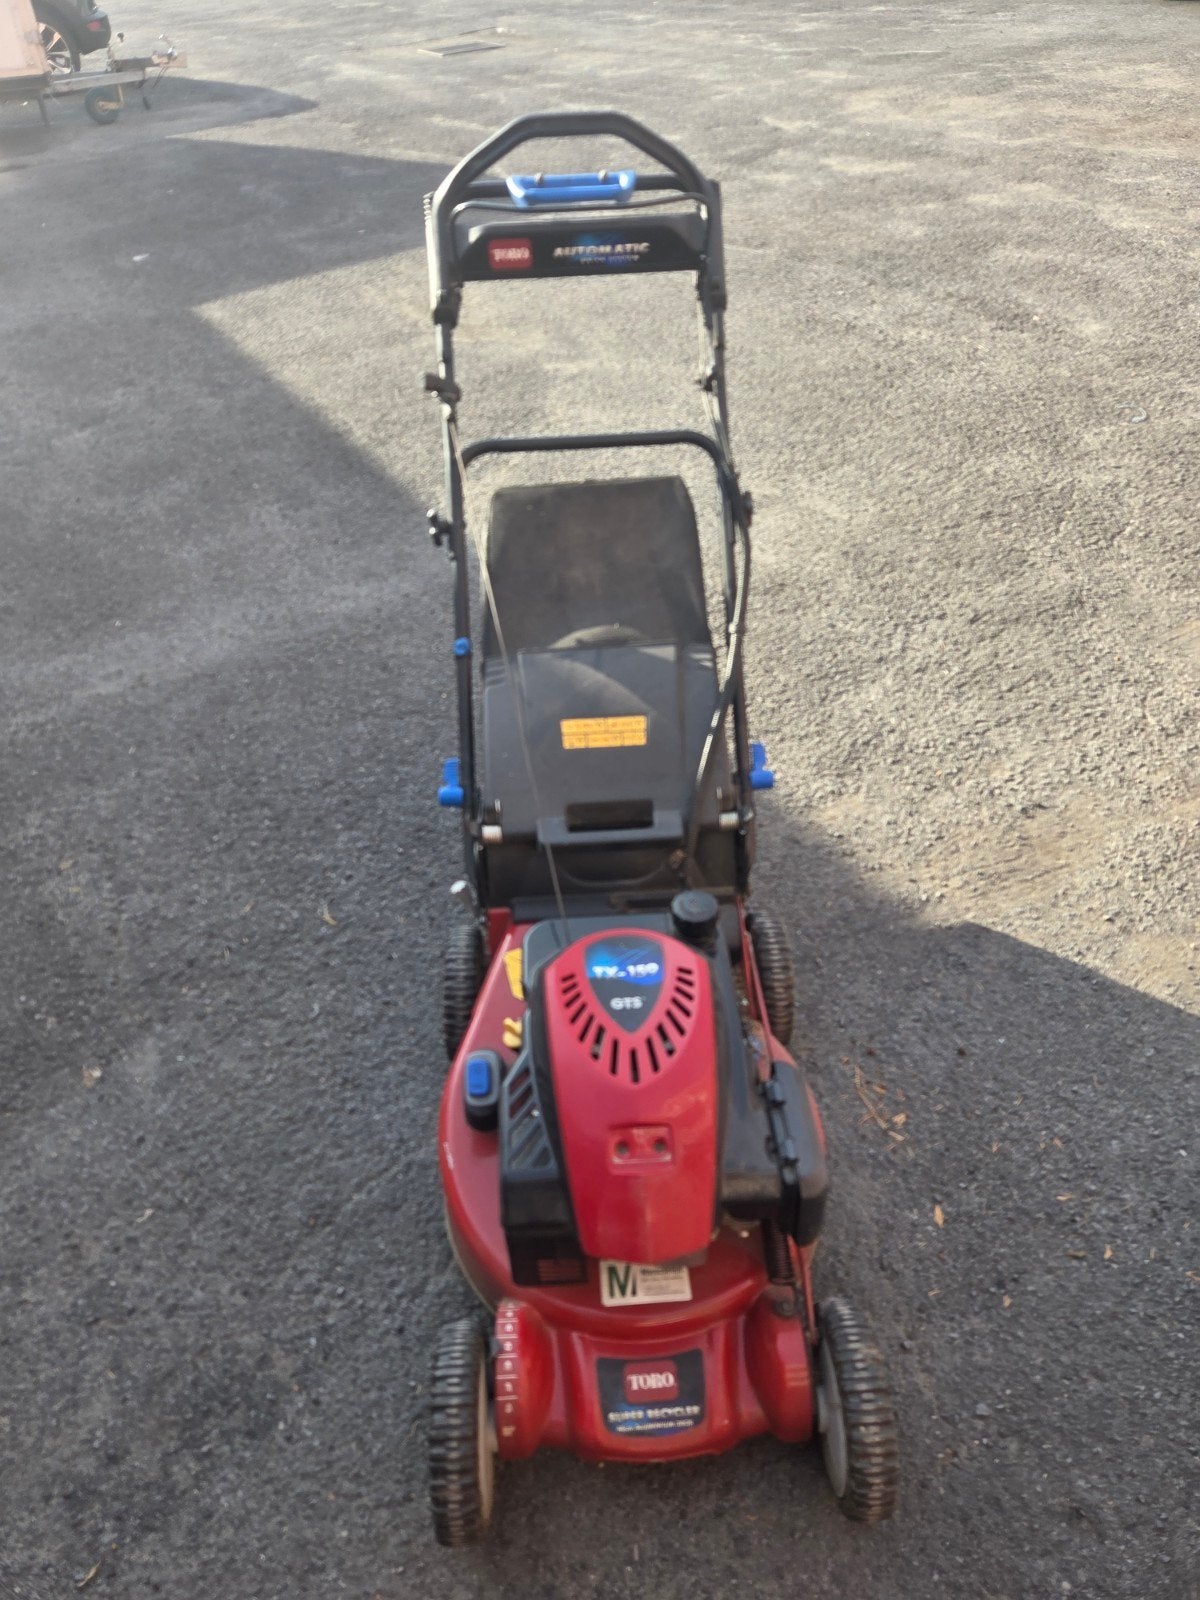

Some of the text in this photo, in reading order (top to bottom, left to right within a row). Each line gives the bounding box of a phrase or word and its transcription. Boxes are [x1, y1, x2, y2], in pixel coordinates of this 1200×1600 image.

[553, 242, 650, 257] AUTOMATIC
[610, 996, 643, 1010] GTS
[627, 1370, 675, 1391] TORO
[608, 1405, 700, 1422] SUPER RECYCLER
